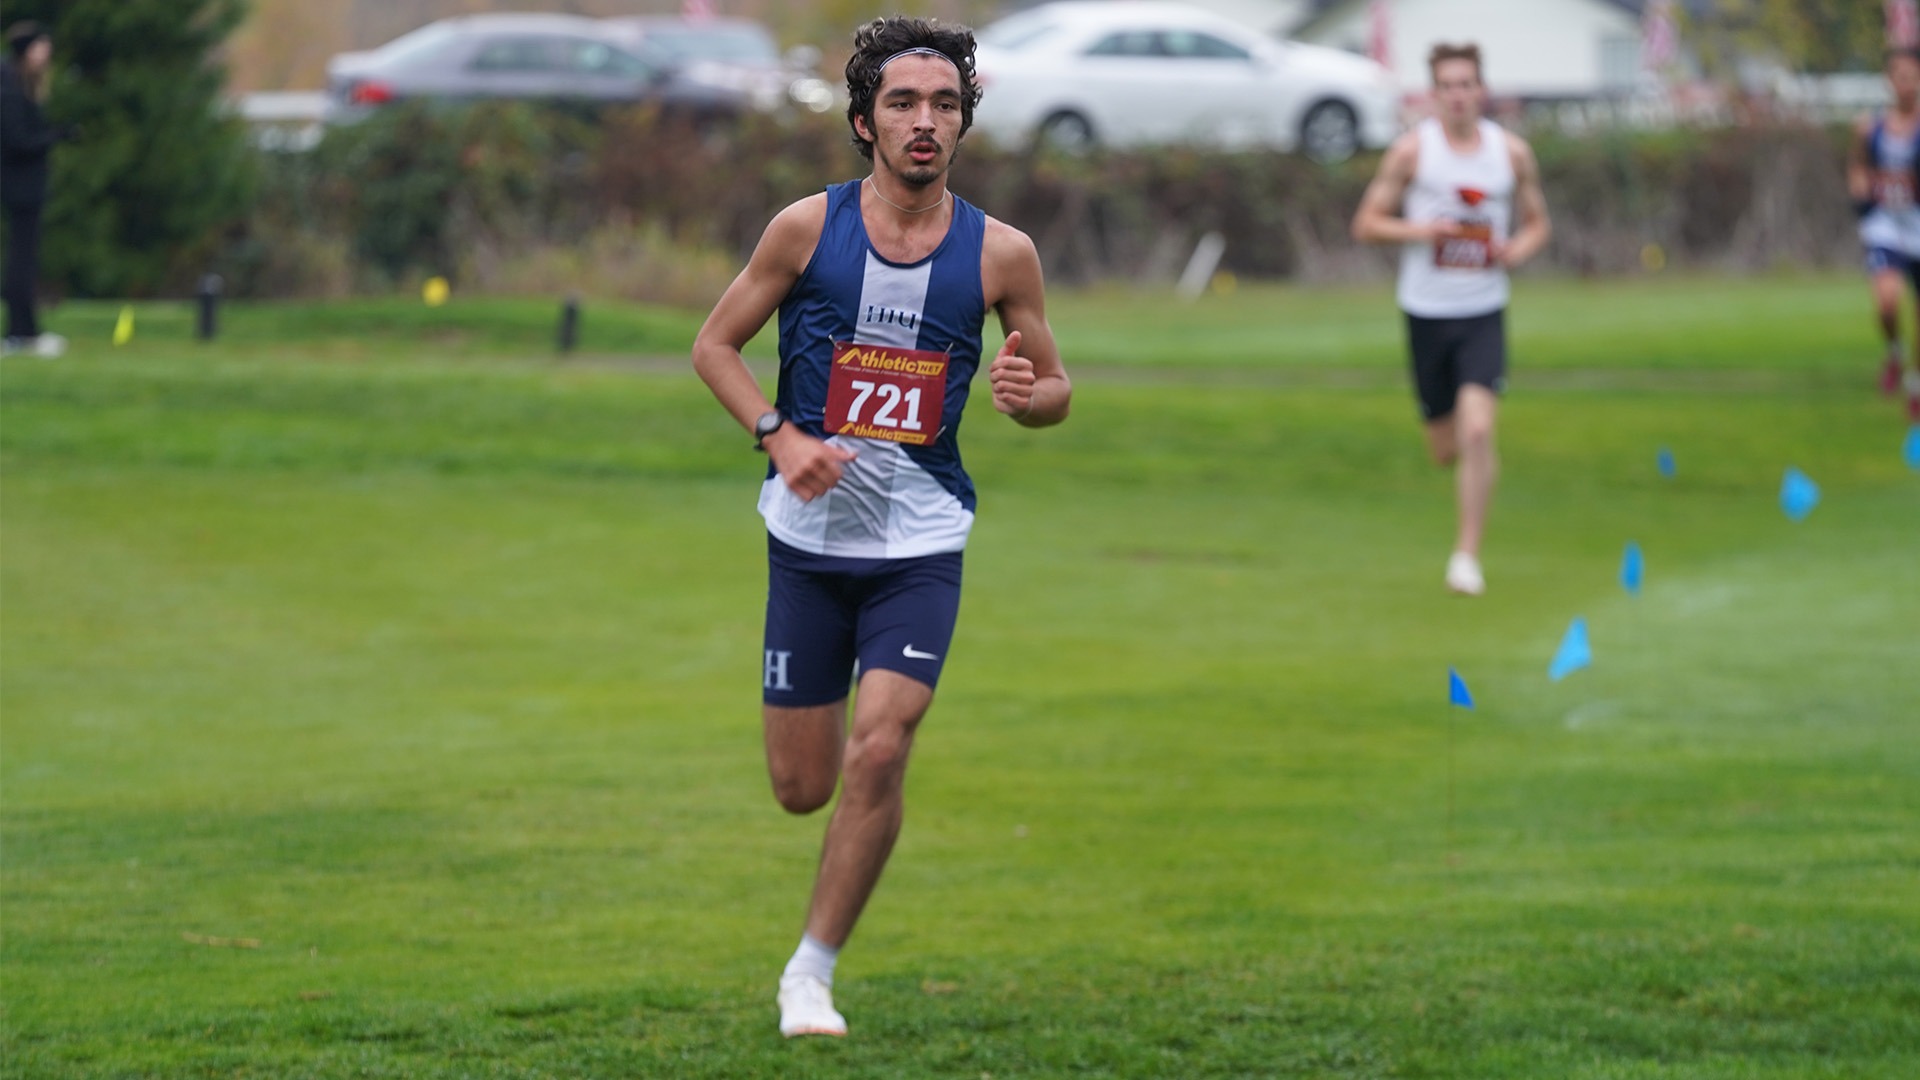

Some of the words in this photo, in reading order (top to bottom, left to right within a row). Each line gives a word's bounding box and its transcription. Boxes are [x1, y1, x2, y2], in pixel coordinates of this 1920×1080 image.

[837, 347, 917, 373] Athletic
[847, 380, 922, 430] 721
[764, 649, 793, 691] H
